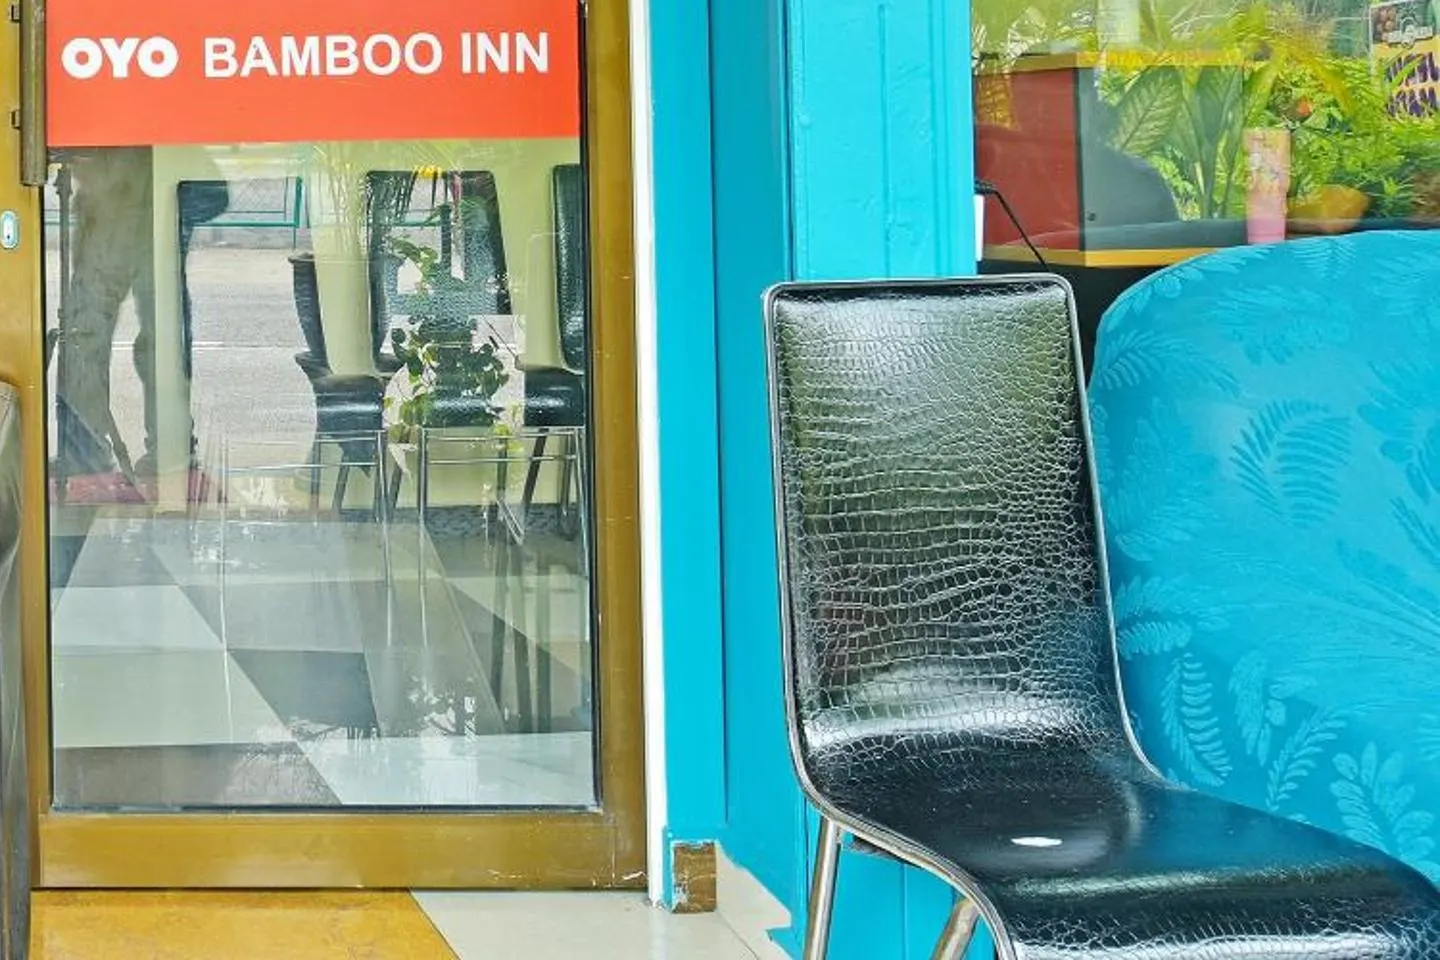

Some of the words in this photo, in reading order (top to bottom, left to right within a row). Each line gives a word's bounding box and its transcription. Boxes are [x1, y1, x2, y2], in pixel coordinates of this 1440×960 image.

[61, 35, 179, 79] OYO
[204, 32, 443, 79] BAMBOO
[461, 31, 549, 74] INN
